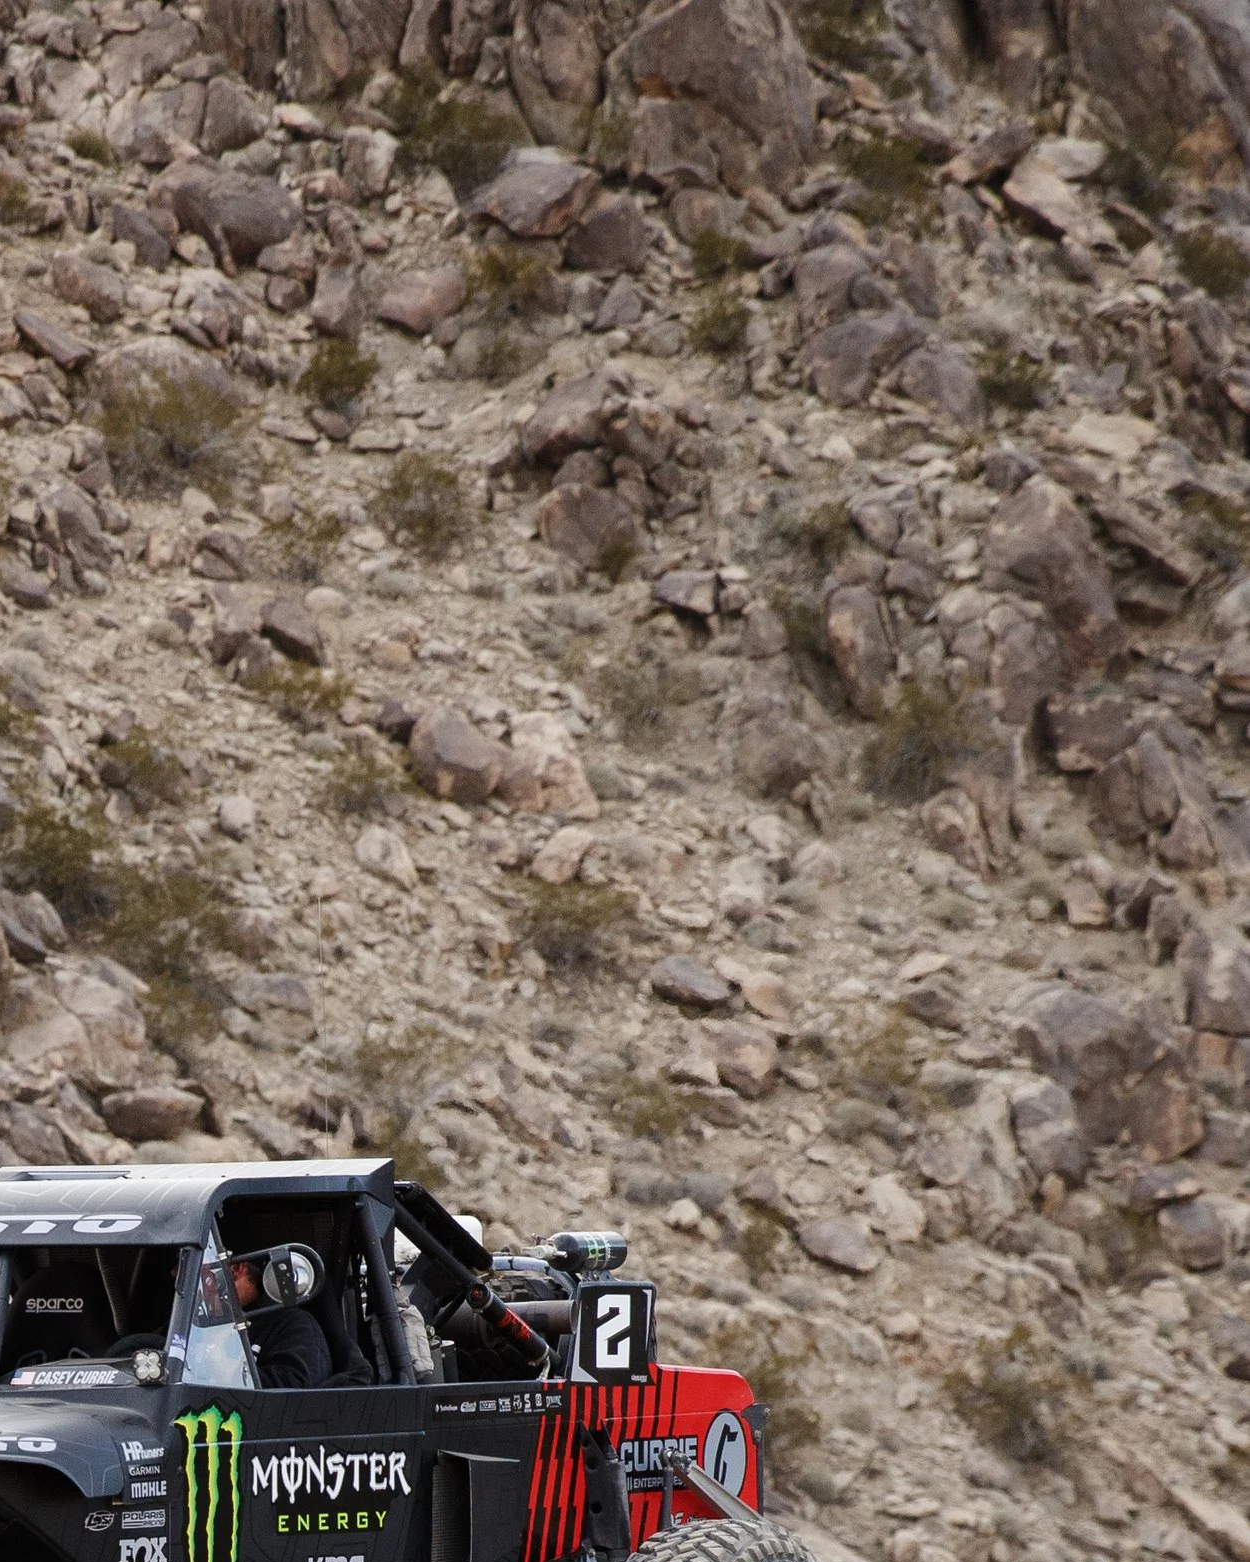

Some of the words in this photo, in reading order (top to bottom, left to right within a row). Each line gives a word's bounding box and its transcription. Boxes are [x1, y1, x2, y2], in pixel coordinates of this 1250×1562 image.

[25, 1297, 84, 1313] sparco
[596, 1294, 631, 1368] 2
[34, 1371, 74, 1385] CASEY
[73, 1371, 119, 1385] CURRIE
[129, 1465, 161, 1477] GARMIN
[251, 1445, 411, 1504] MONSTER
[131, 1480, 167, 1499] MAHLE
[122, 1510, 165, 1521] POLARIS
[277, 1510, 387, 1533] ENERGY
